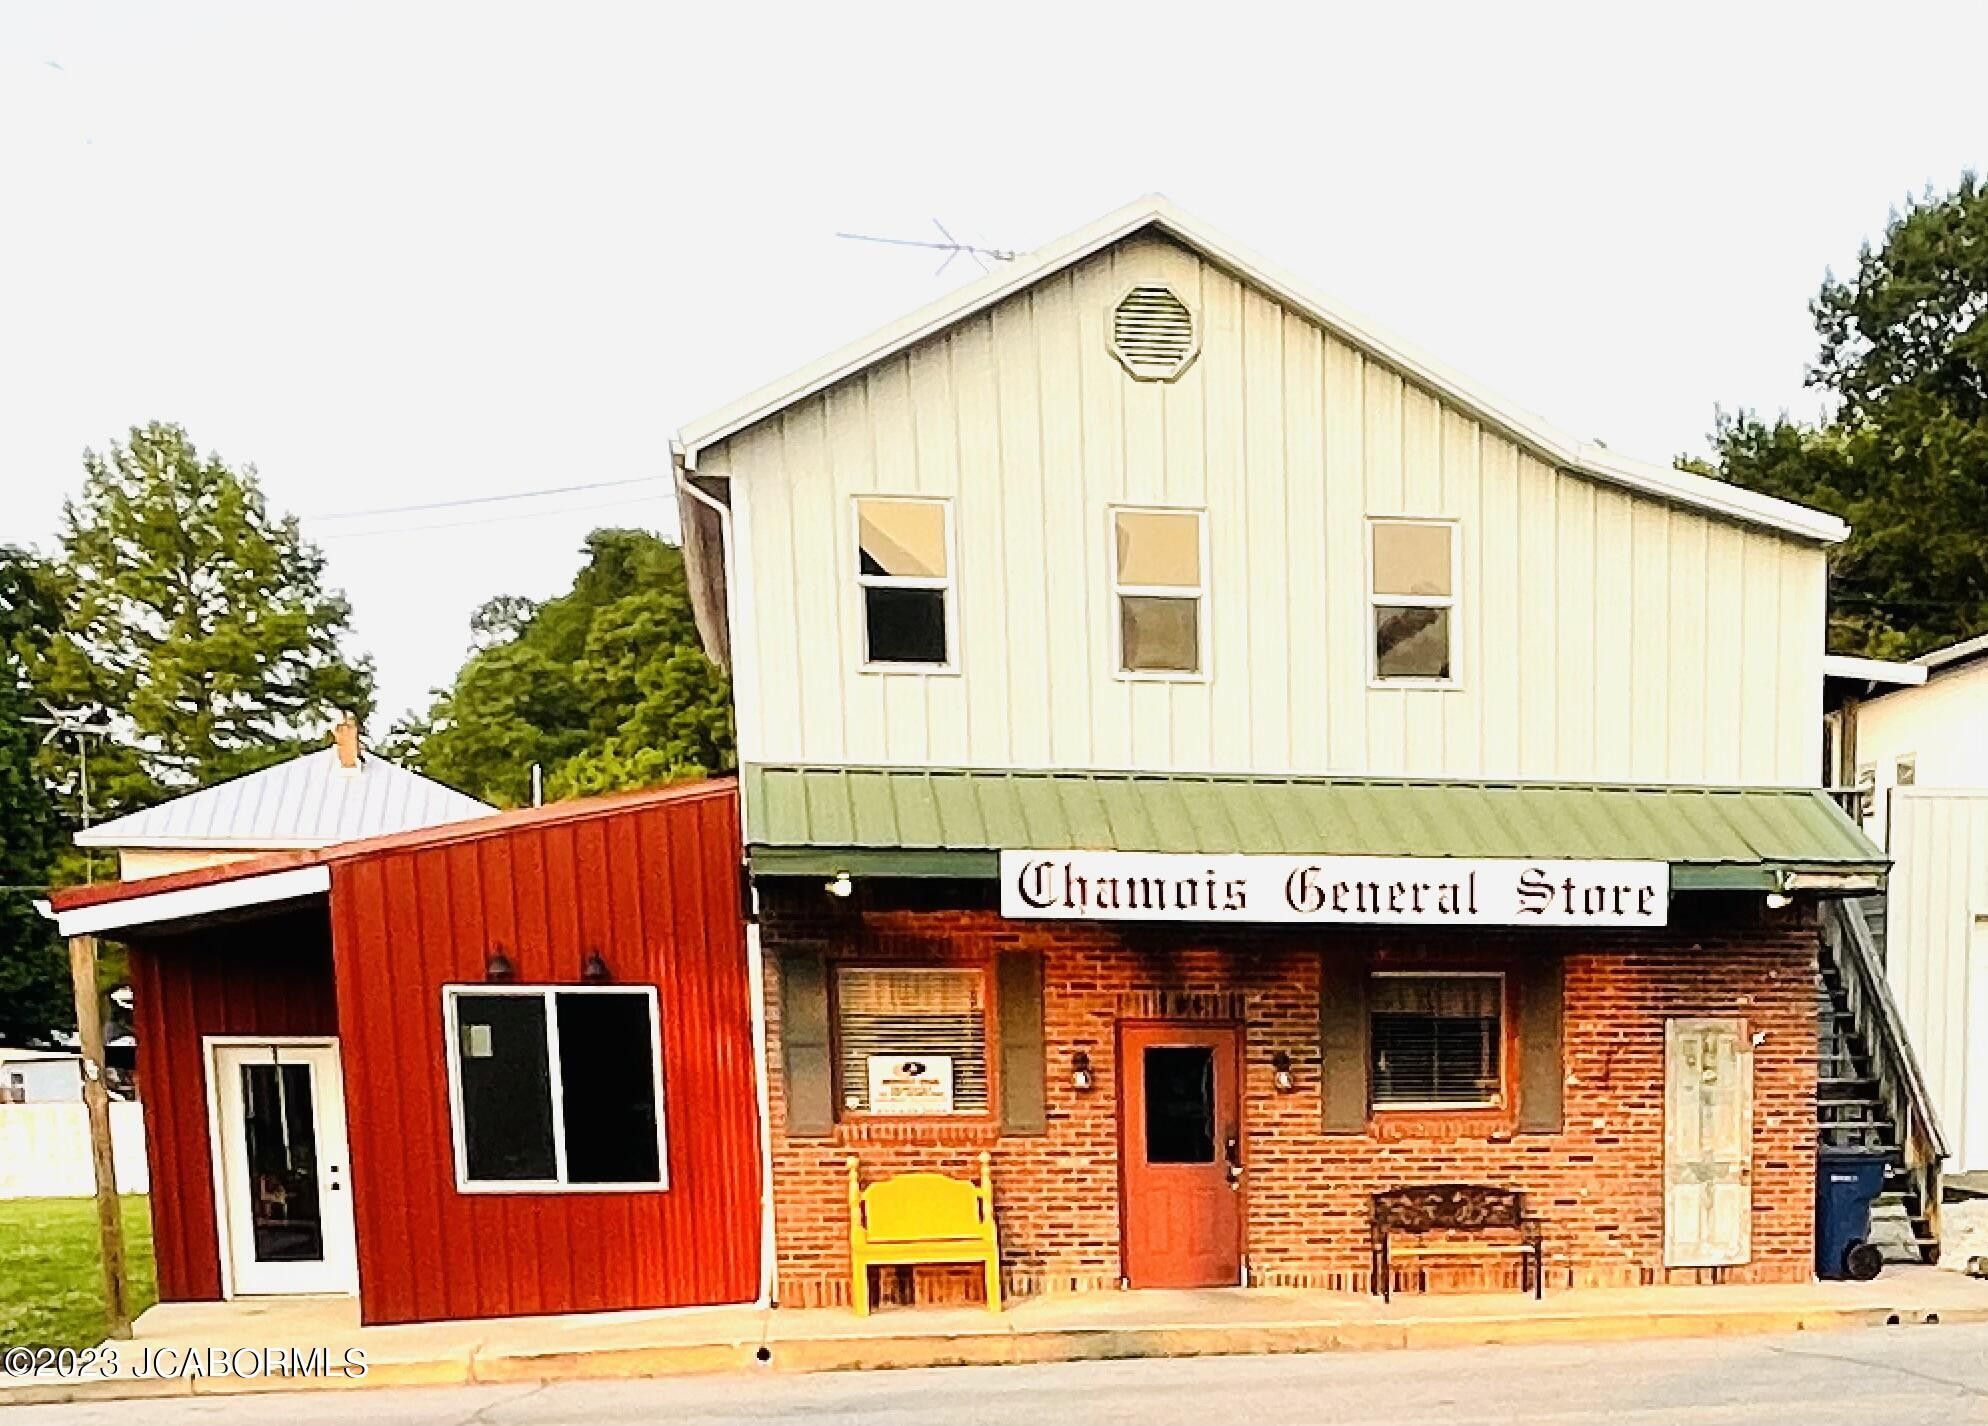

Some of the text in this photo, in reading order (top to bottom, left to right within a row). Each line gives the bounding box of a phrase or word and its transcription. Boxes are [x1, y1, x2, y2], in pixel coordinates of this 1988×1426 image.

[1018, 860, 1656, 917] Chamois General Store
